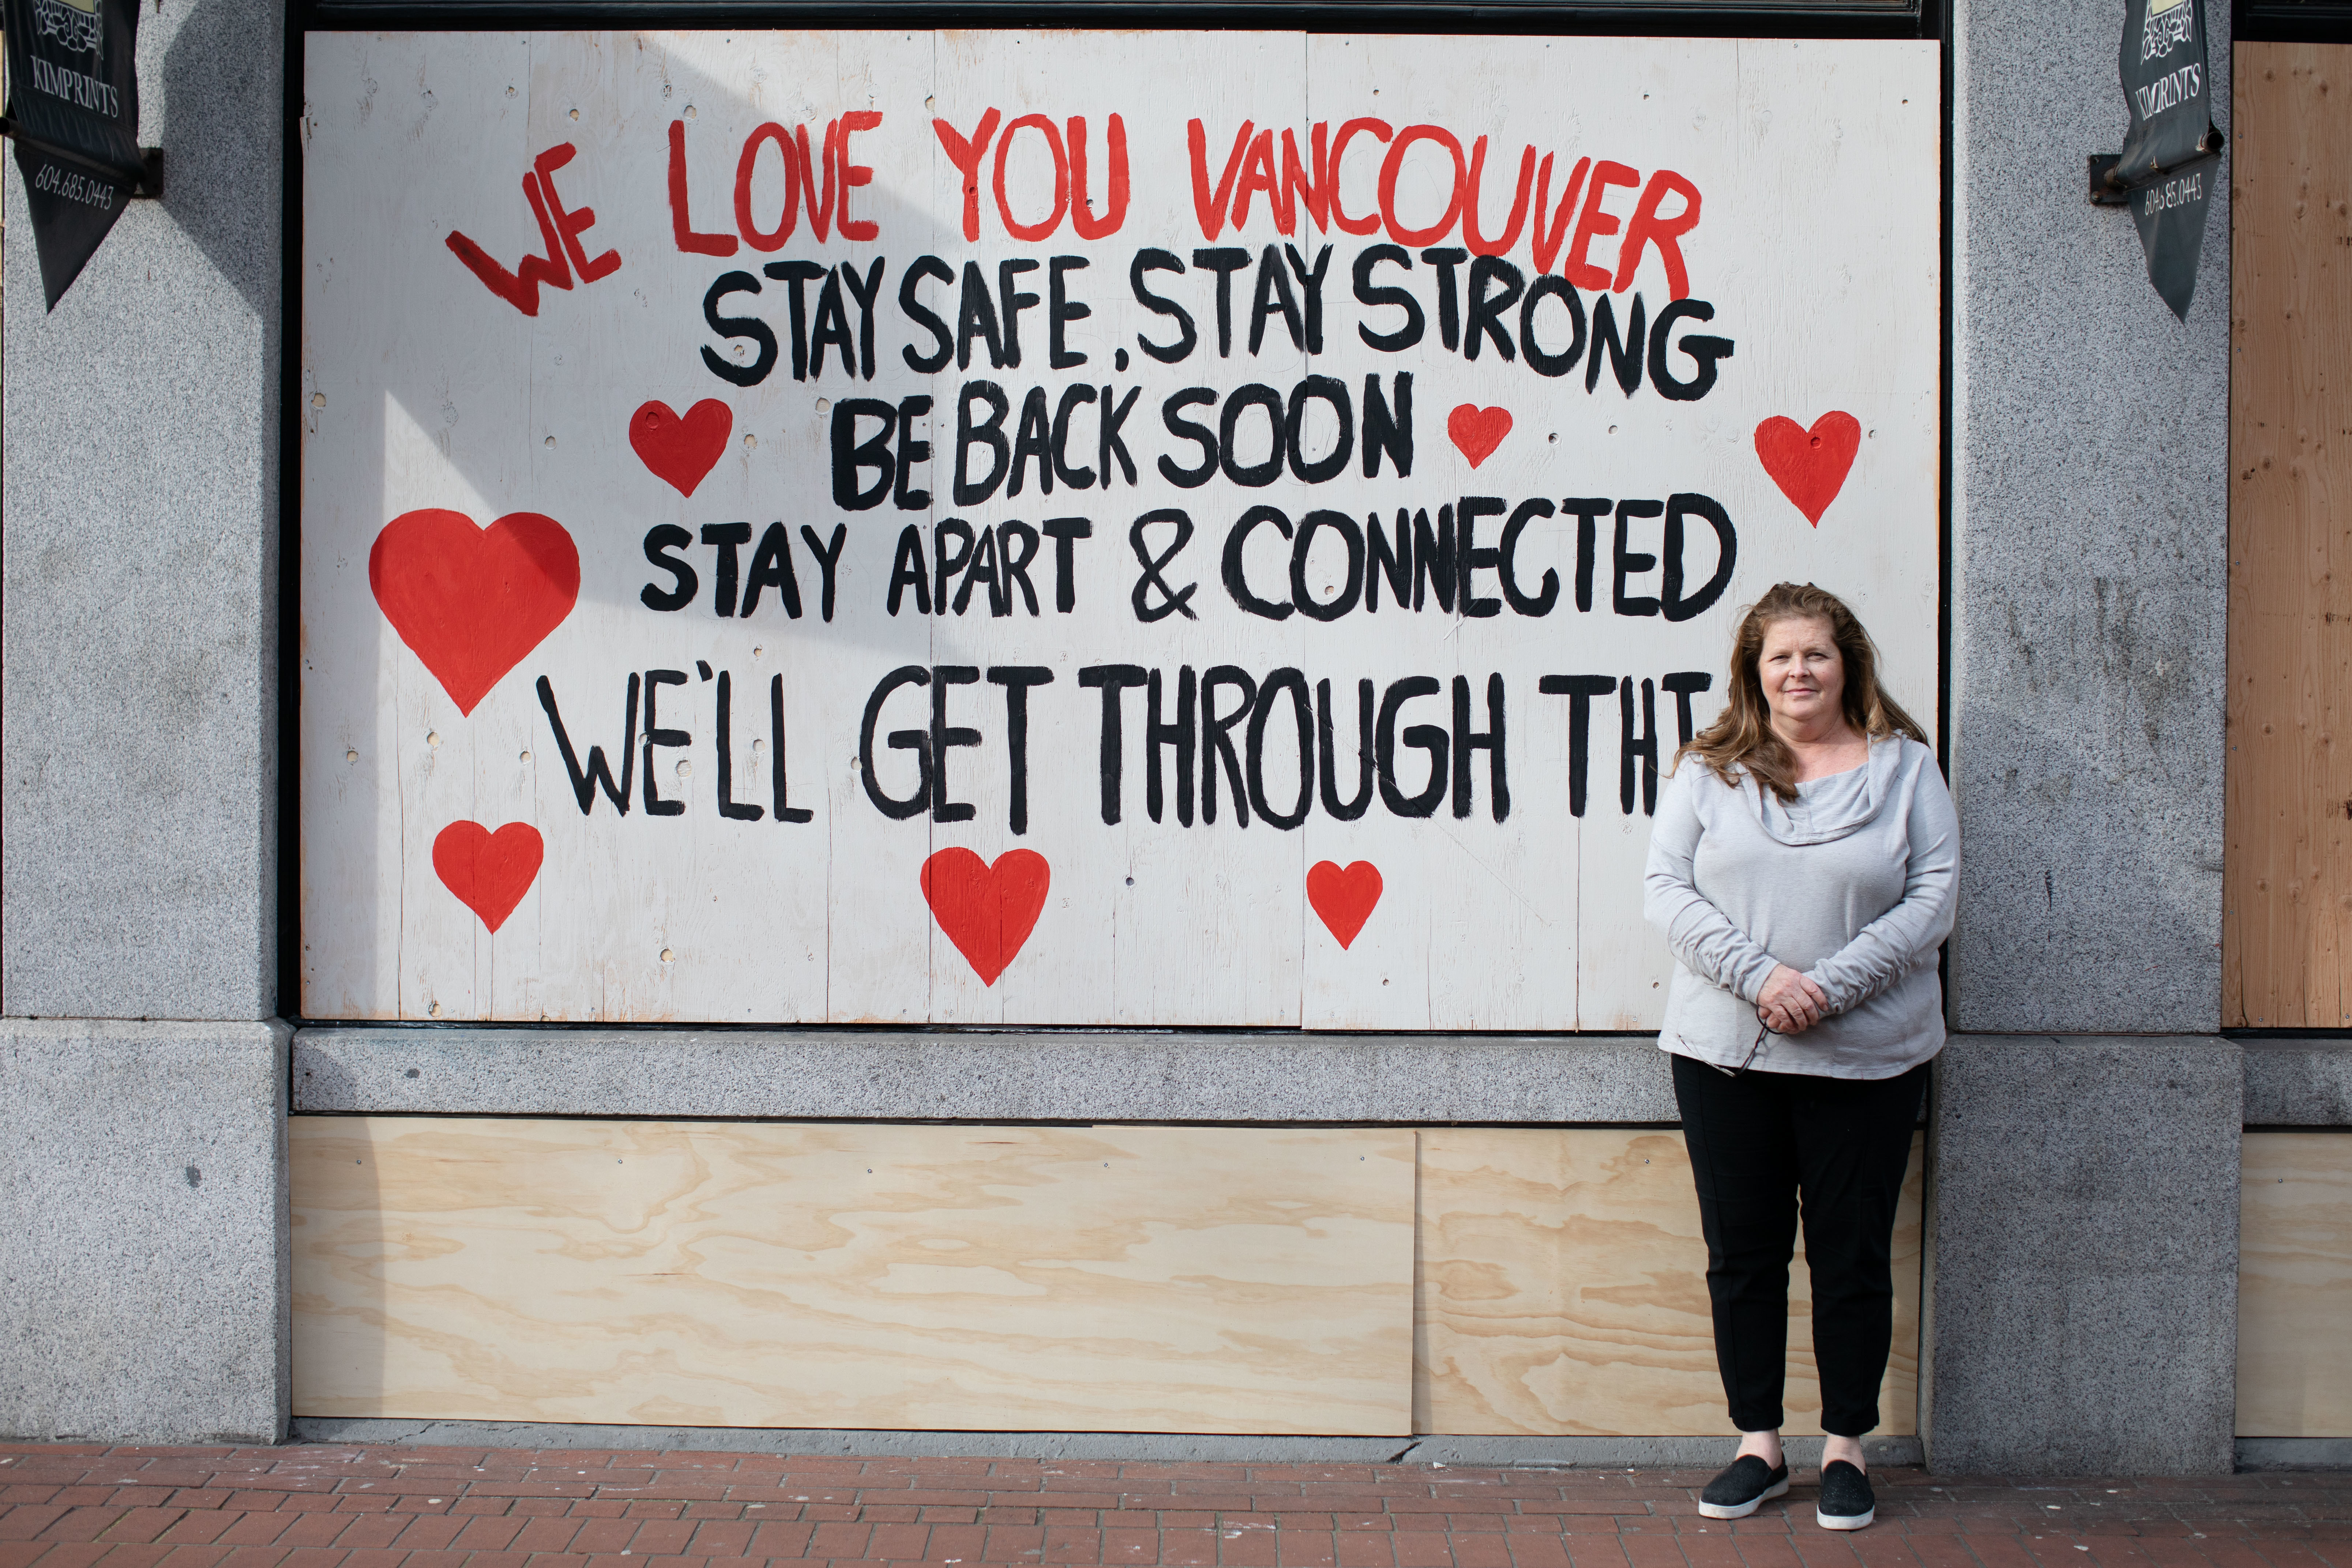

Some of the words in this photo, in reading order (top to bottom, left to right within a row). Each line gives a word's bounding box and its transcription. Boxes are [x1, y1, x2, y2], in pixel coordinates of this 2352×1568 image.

[30, 55, 118, 118] KIMPRINTS
[2135, 63, 2201, 121] KIMRINTS
[35, 164, 114, 210] 604.685.0443
[444, 142, 622, 317] WE
[668, 110, 883, 257] LOVE
[932, 106, 1130, 242] YOU
[1187, 117, 1702, 302] VANCOUVER
[700, 256, 885, 388] STAY
[1130, 243, 1334, 363] STAY
[1352, 242, 1735, 402] STRONG
[831, 395, 934, 511] BE
[953, 380, 1141, 507] BACK
[1158, 371, 1413, 488] SOON
[640, 522, 847, 623] STAY
[886, 517, 1093, 617] APART
[1129, 508, 1199, 623] &
[1221, 493, 1737, 622] CONNECTED
[536, 660, 814, 823] WE'LL
[859, 665, 1055, 835] GET
[1079, 664, 1510, 831] THROUGH
